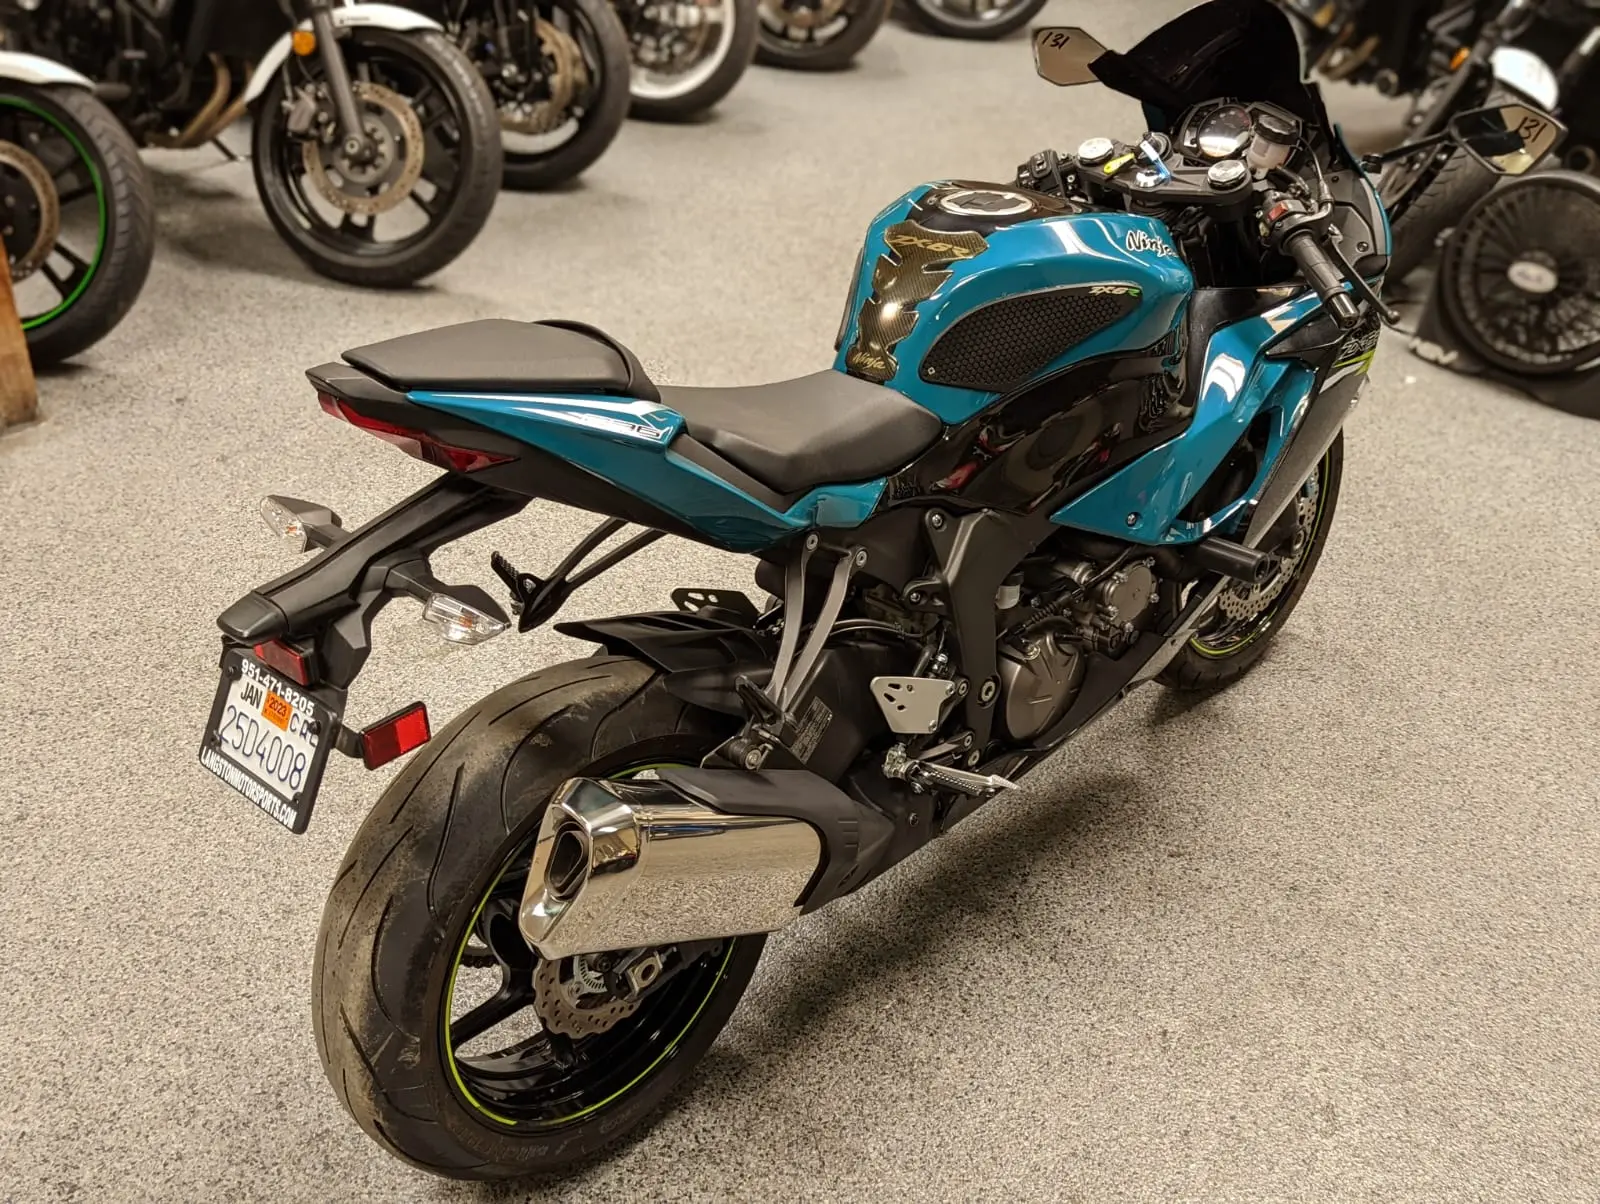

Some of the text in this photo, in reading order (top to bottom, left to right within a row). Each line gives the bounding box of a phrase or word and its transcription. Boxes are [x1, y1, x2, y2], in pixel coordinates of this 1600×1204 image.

[1042, 31, 1070, 50] 131
[1514, 116, 1548, 143] 131
[1126, 230, 1180, 258] Ninja
[240, 658, 315, 718] 951-471-8205
[240, 682, 263, 710] JAN
[268, 696, 288, 718] 2023
[218, 705, 306, 791] 25D4008
[201, 746, 298, 830] LANGSTONMOTORSPORTS.COM
